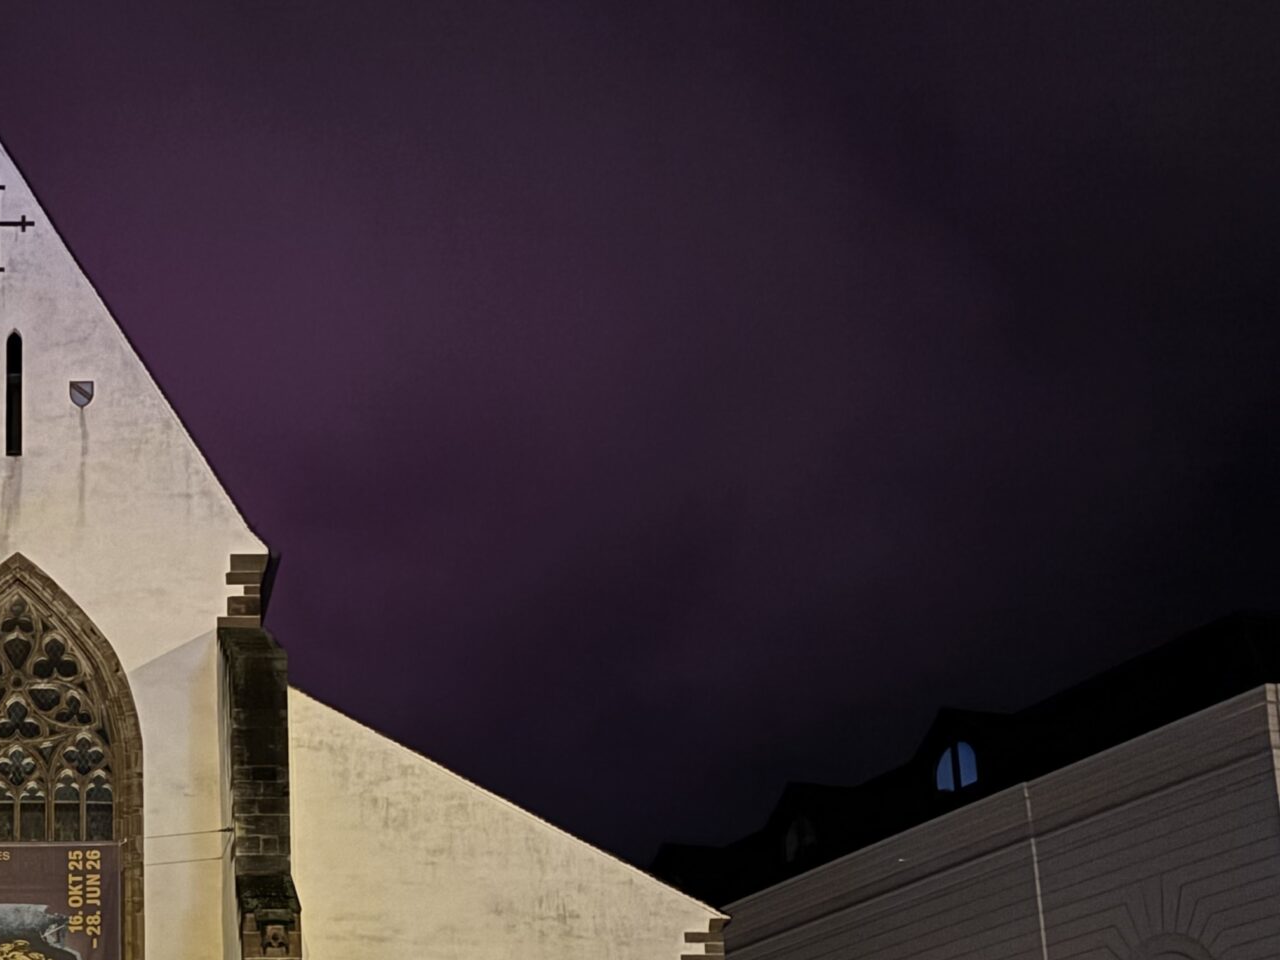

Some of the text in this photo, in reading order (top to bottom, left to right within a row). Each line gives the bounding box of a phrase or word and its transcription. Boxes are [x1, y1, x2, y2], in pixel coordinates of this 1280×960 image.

[86, 849, 102, 870] 26
[68, 850, 84, 934] 16. OKT 25
[86, 873, 102, 906] JUN
